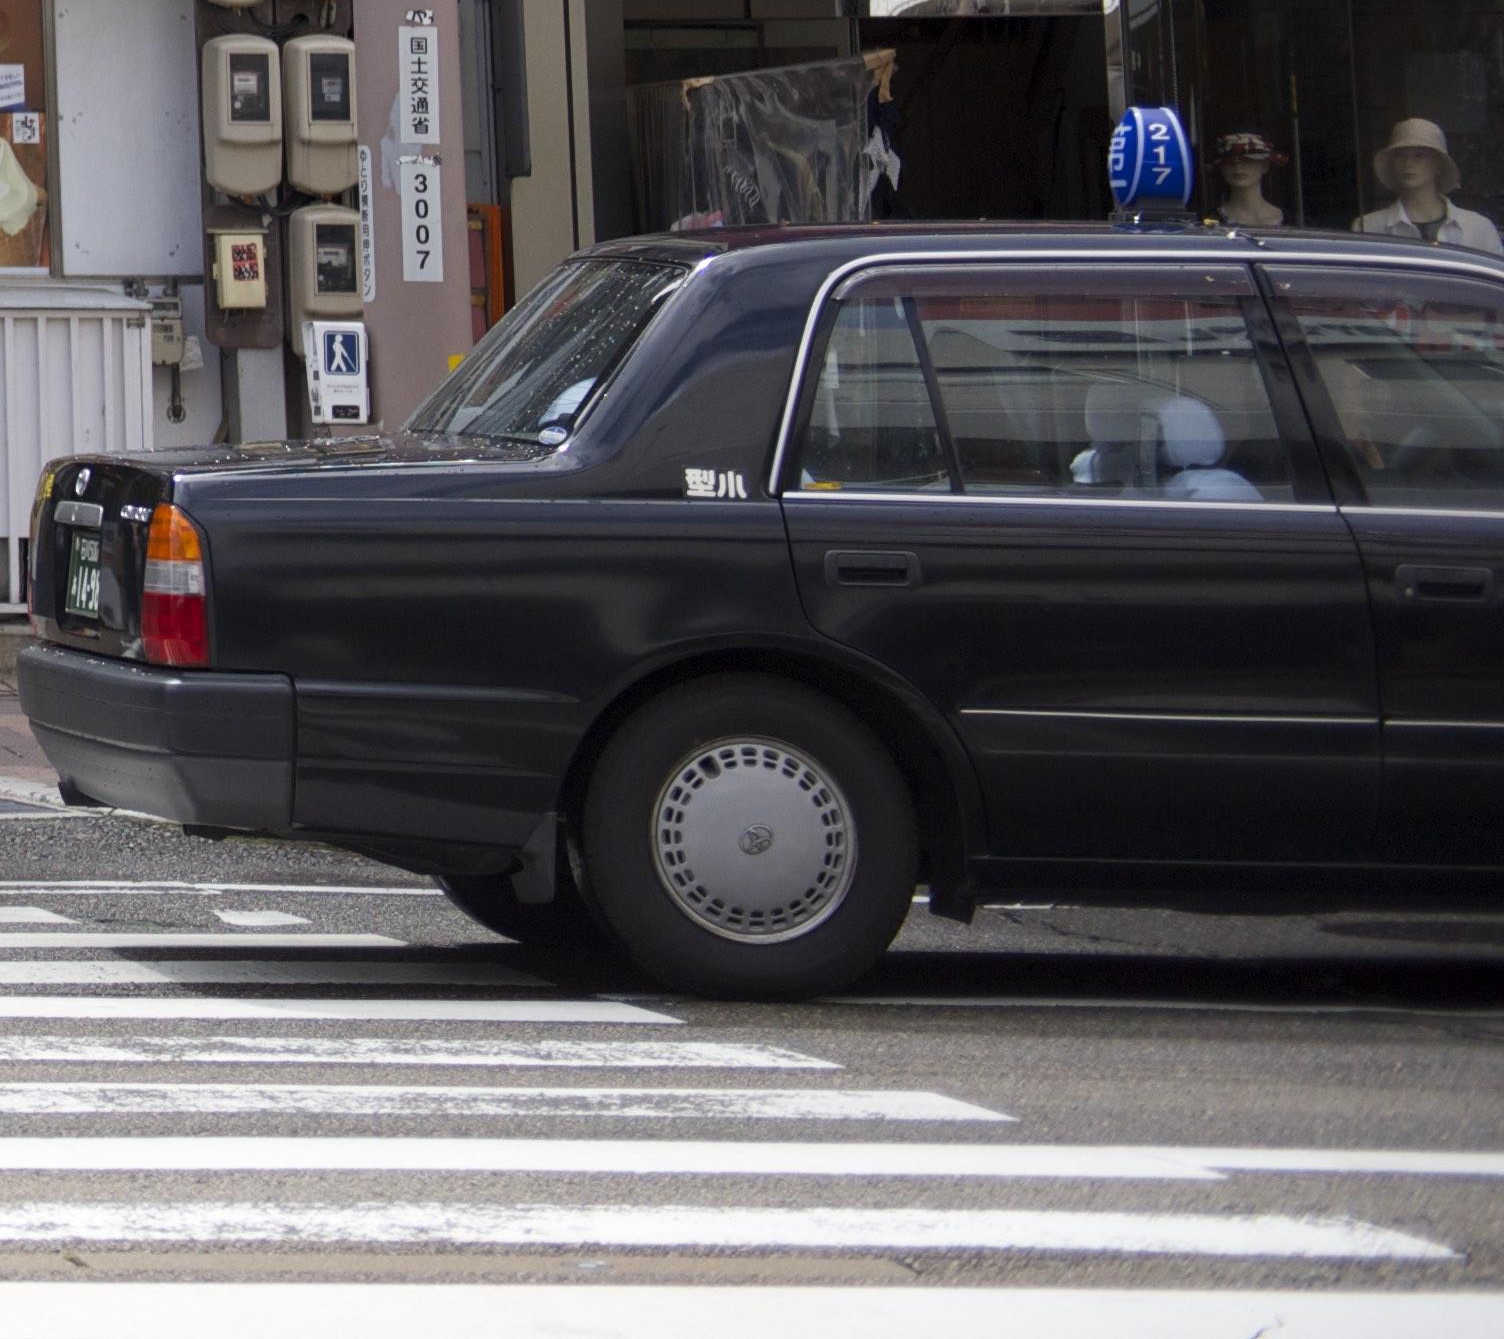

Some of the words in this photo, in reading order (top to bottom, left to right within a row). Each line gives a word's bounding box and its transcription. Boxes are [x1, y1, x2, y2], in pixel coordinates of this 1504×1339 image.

[409, 36, 430, 135] 国土交通省
[1148, 123, 1173, 185] 217
[414, 173, 431, 270] 3007
